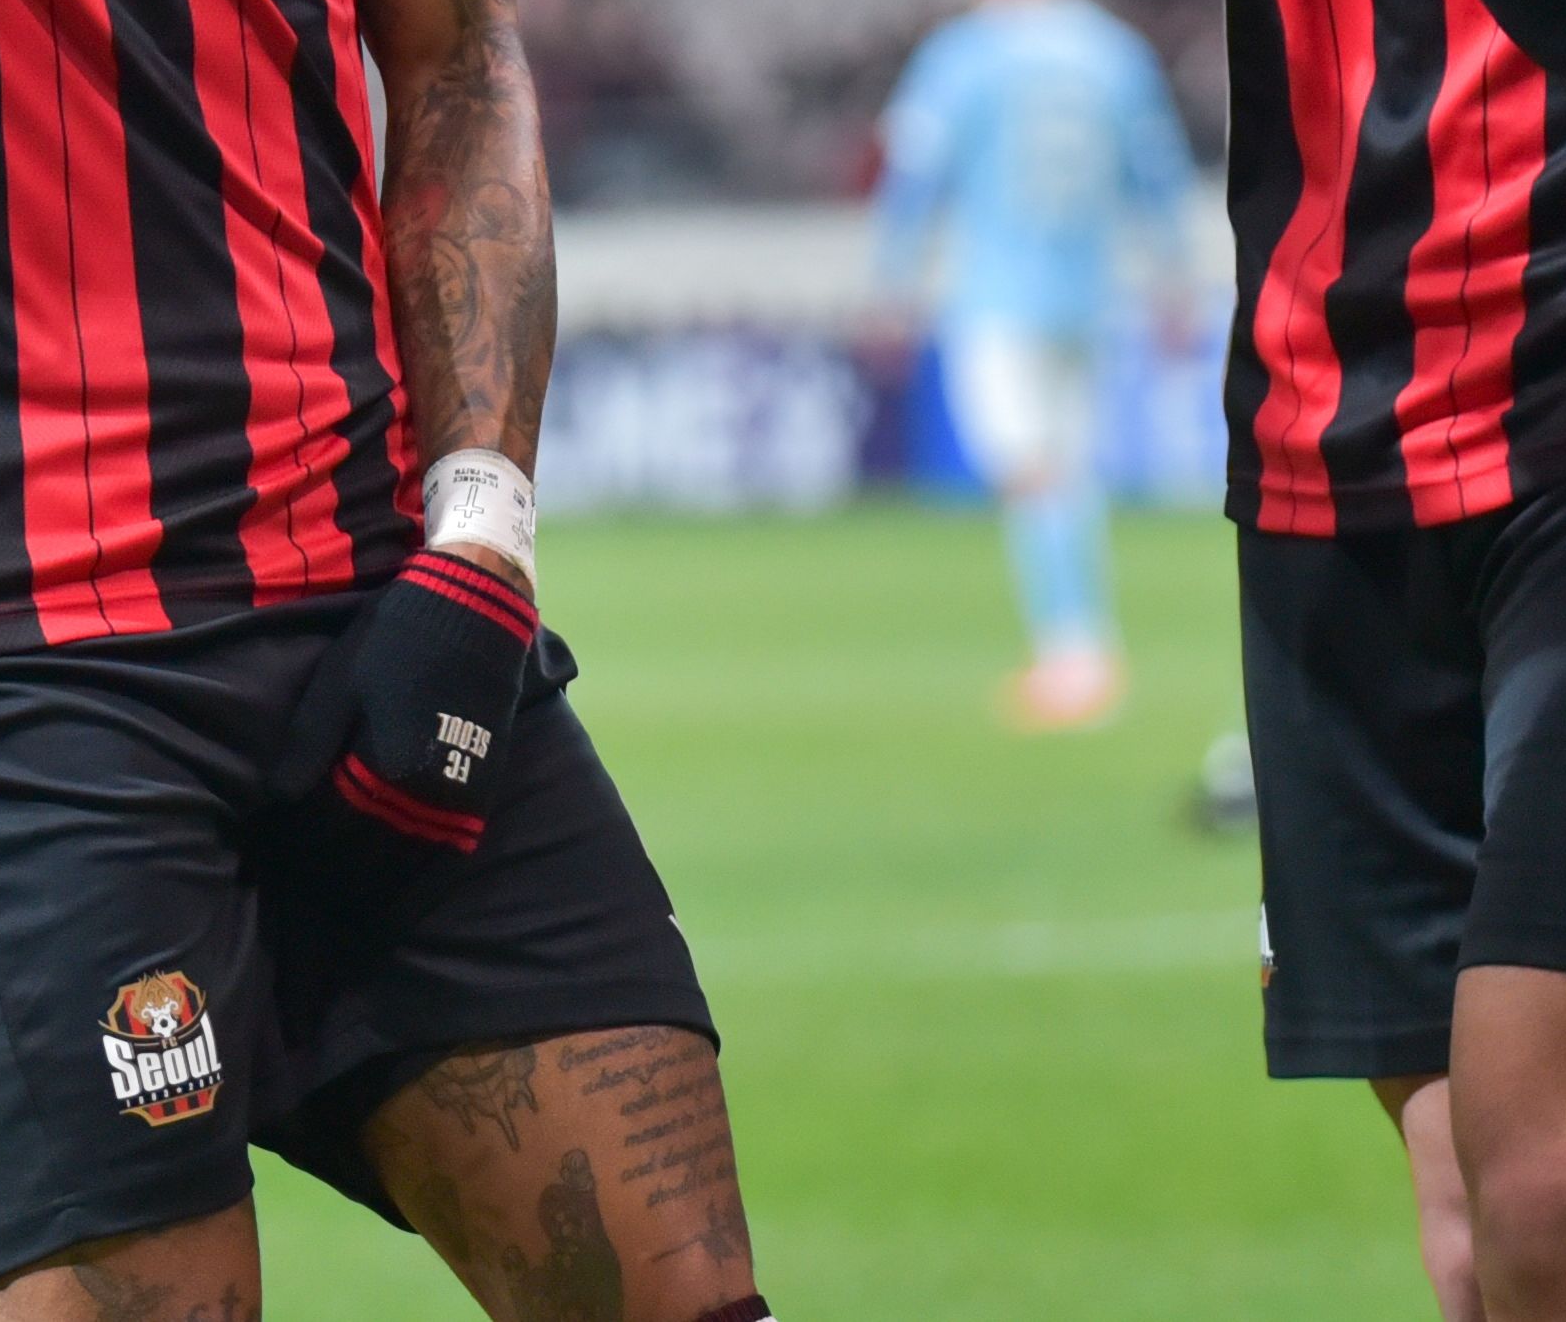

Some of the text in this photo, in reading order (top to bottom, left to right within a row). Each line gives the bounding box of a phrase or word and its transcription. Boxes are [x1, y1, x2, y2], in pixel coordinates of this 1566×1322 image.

[436, 711, 492, 758] SEOUL
[442, 749, 471, 784] FC
[102, 1009, 222, 1100] Seoul
